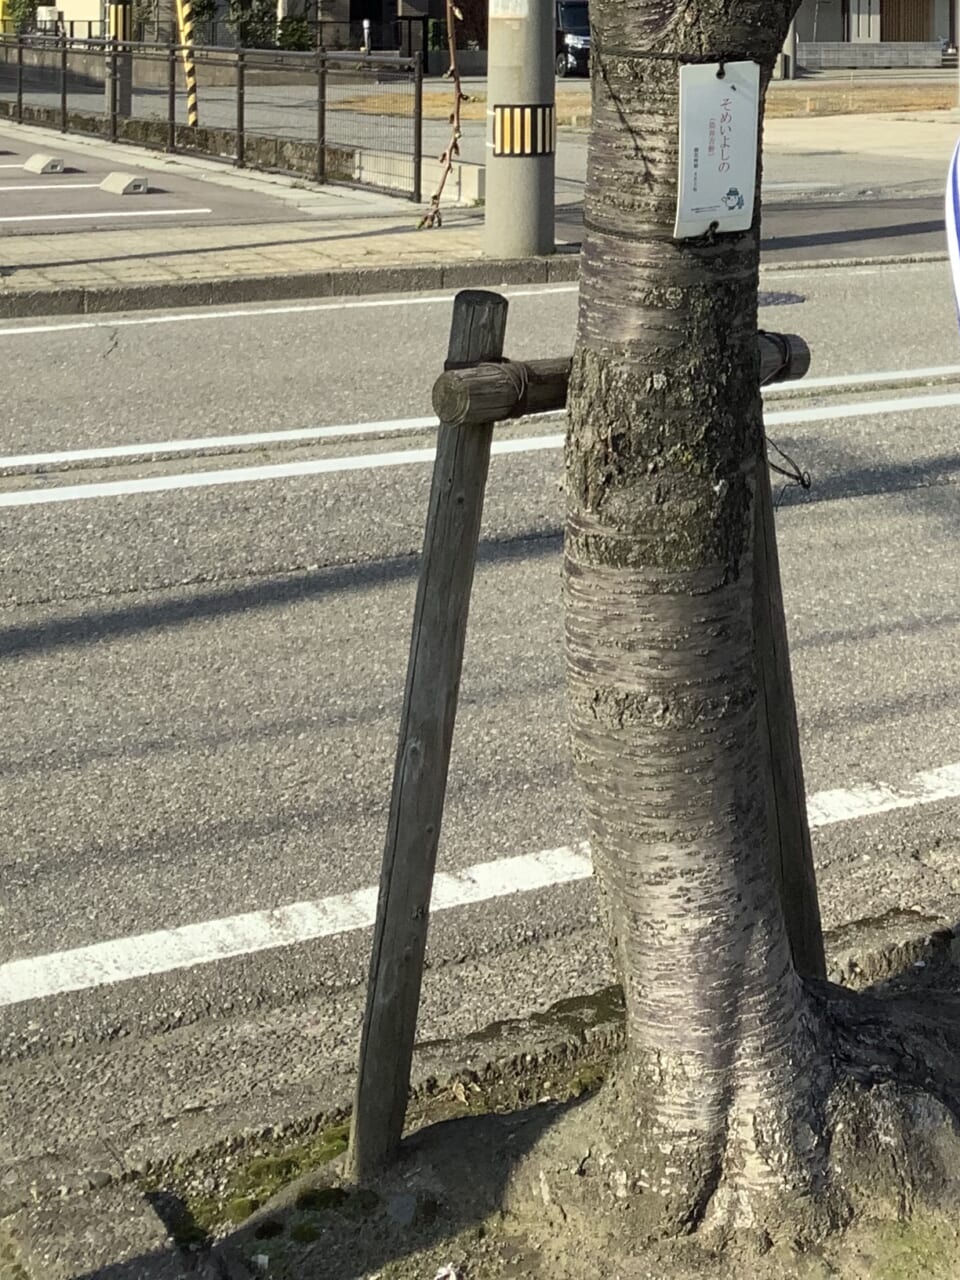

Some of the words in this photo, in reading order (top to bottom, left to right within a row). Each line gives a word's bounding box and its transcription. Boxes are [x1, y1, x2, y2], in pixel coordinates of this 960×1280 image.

[718, 98, 732, 173] そめいよしの
